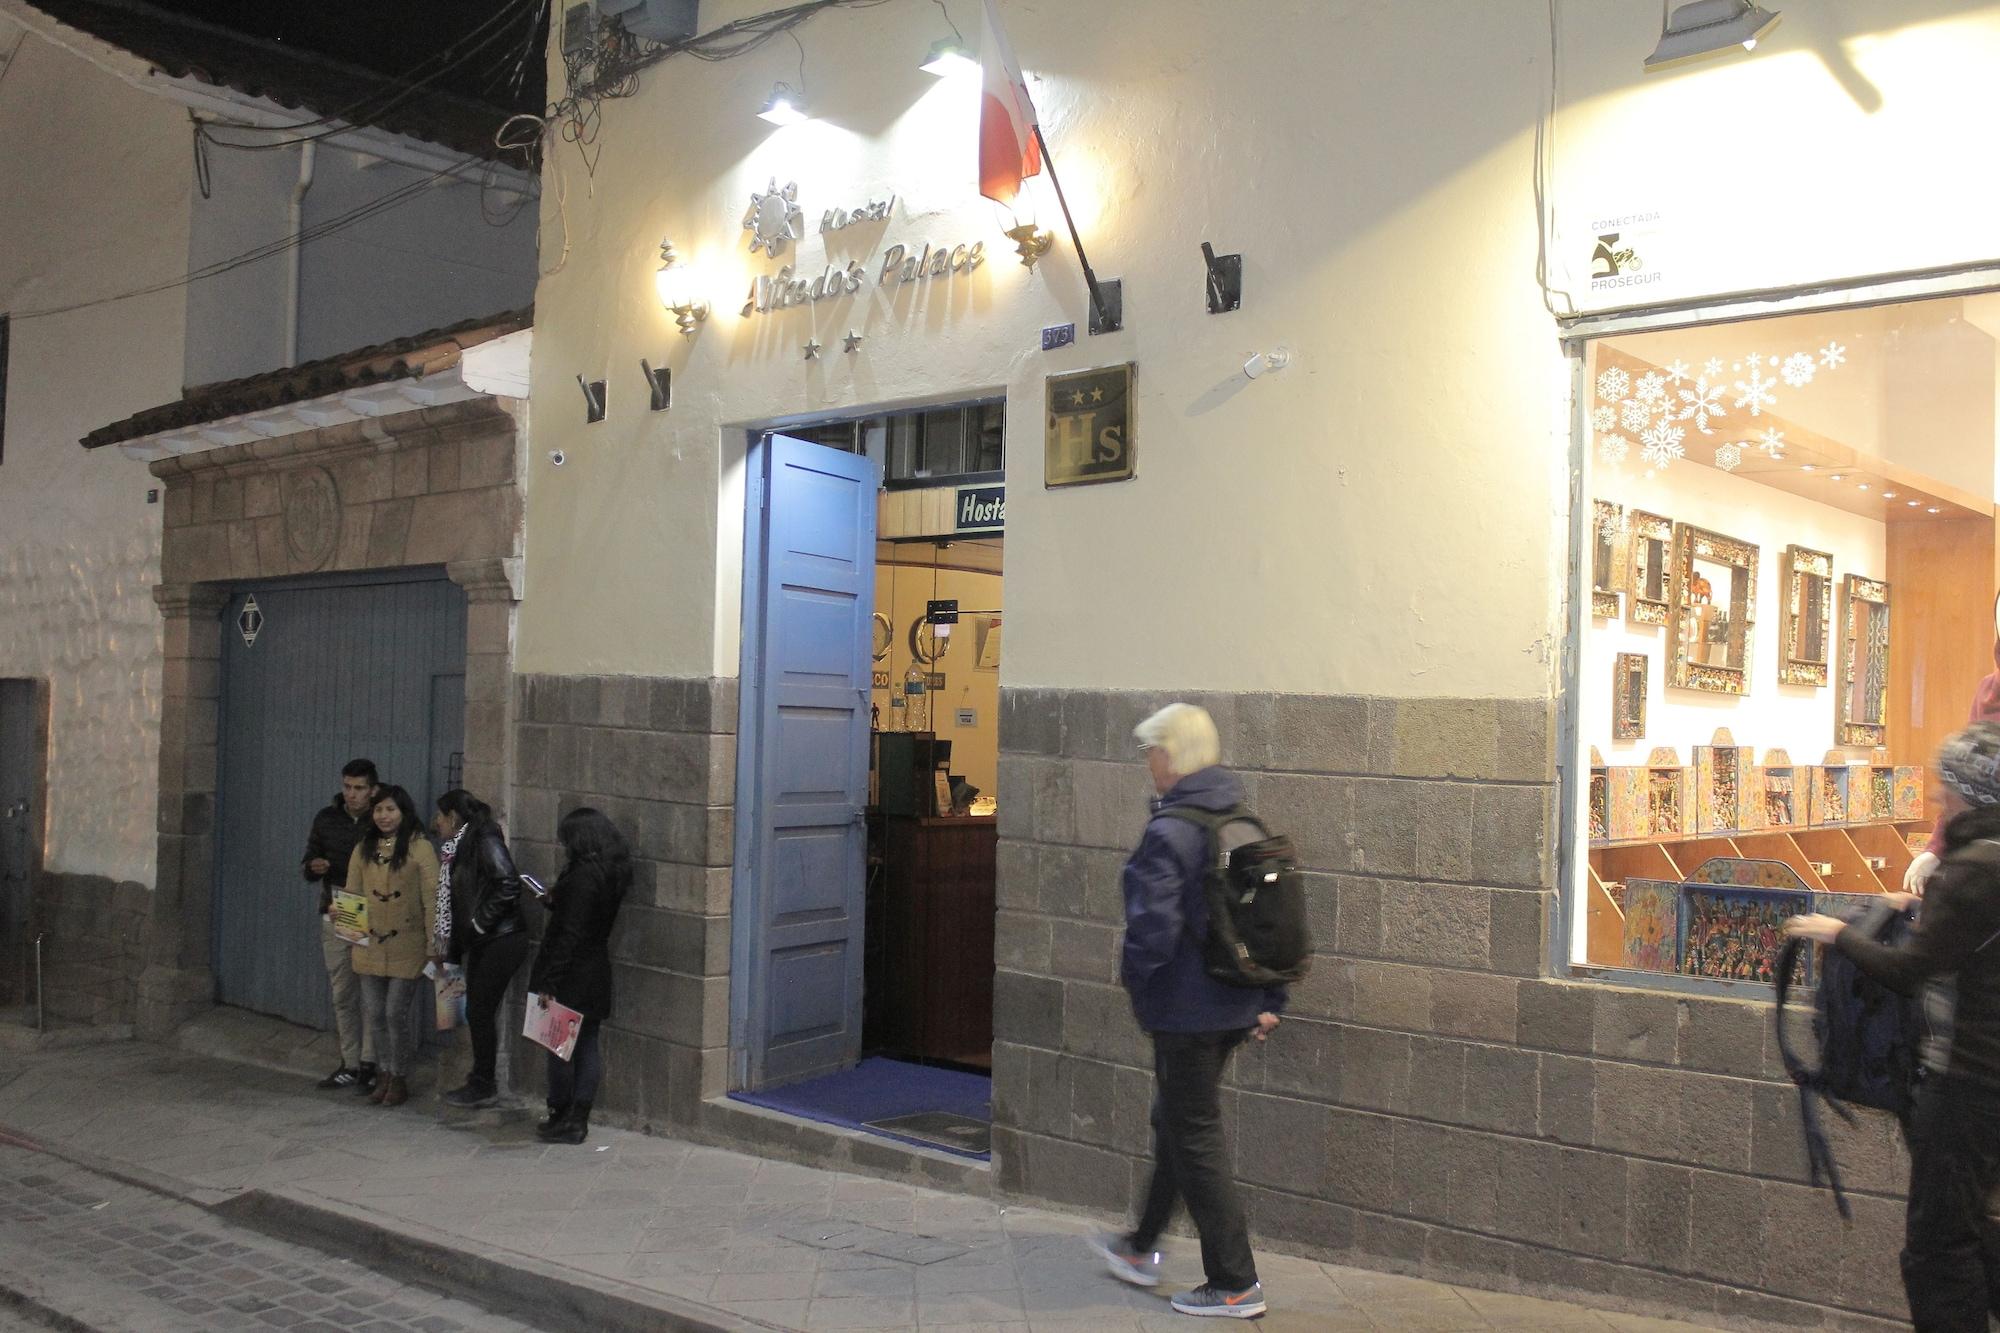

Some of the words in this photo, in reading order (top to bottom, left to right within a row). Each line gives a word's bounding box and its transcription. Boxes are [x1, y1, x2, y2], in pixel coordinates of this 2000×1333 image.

[819, 194, 896, 233] Hostal
[1591, 211, 1661, 231] CONECTADA
[878, 240, 984, 287] Palace
[1591, 272, 1661, 291] PROSEGUR
[1044, 326, 1069, 345] 373
